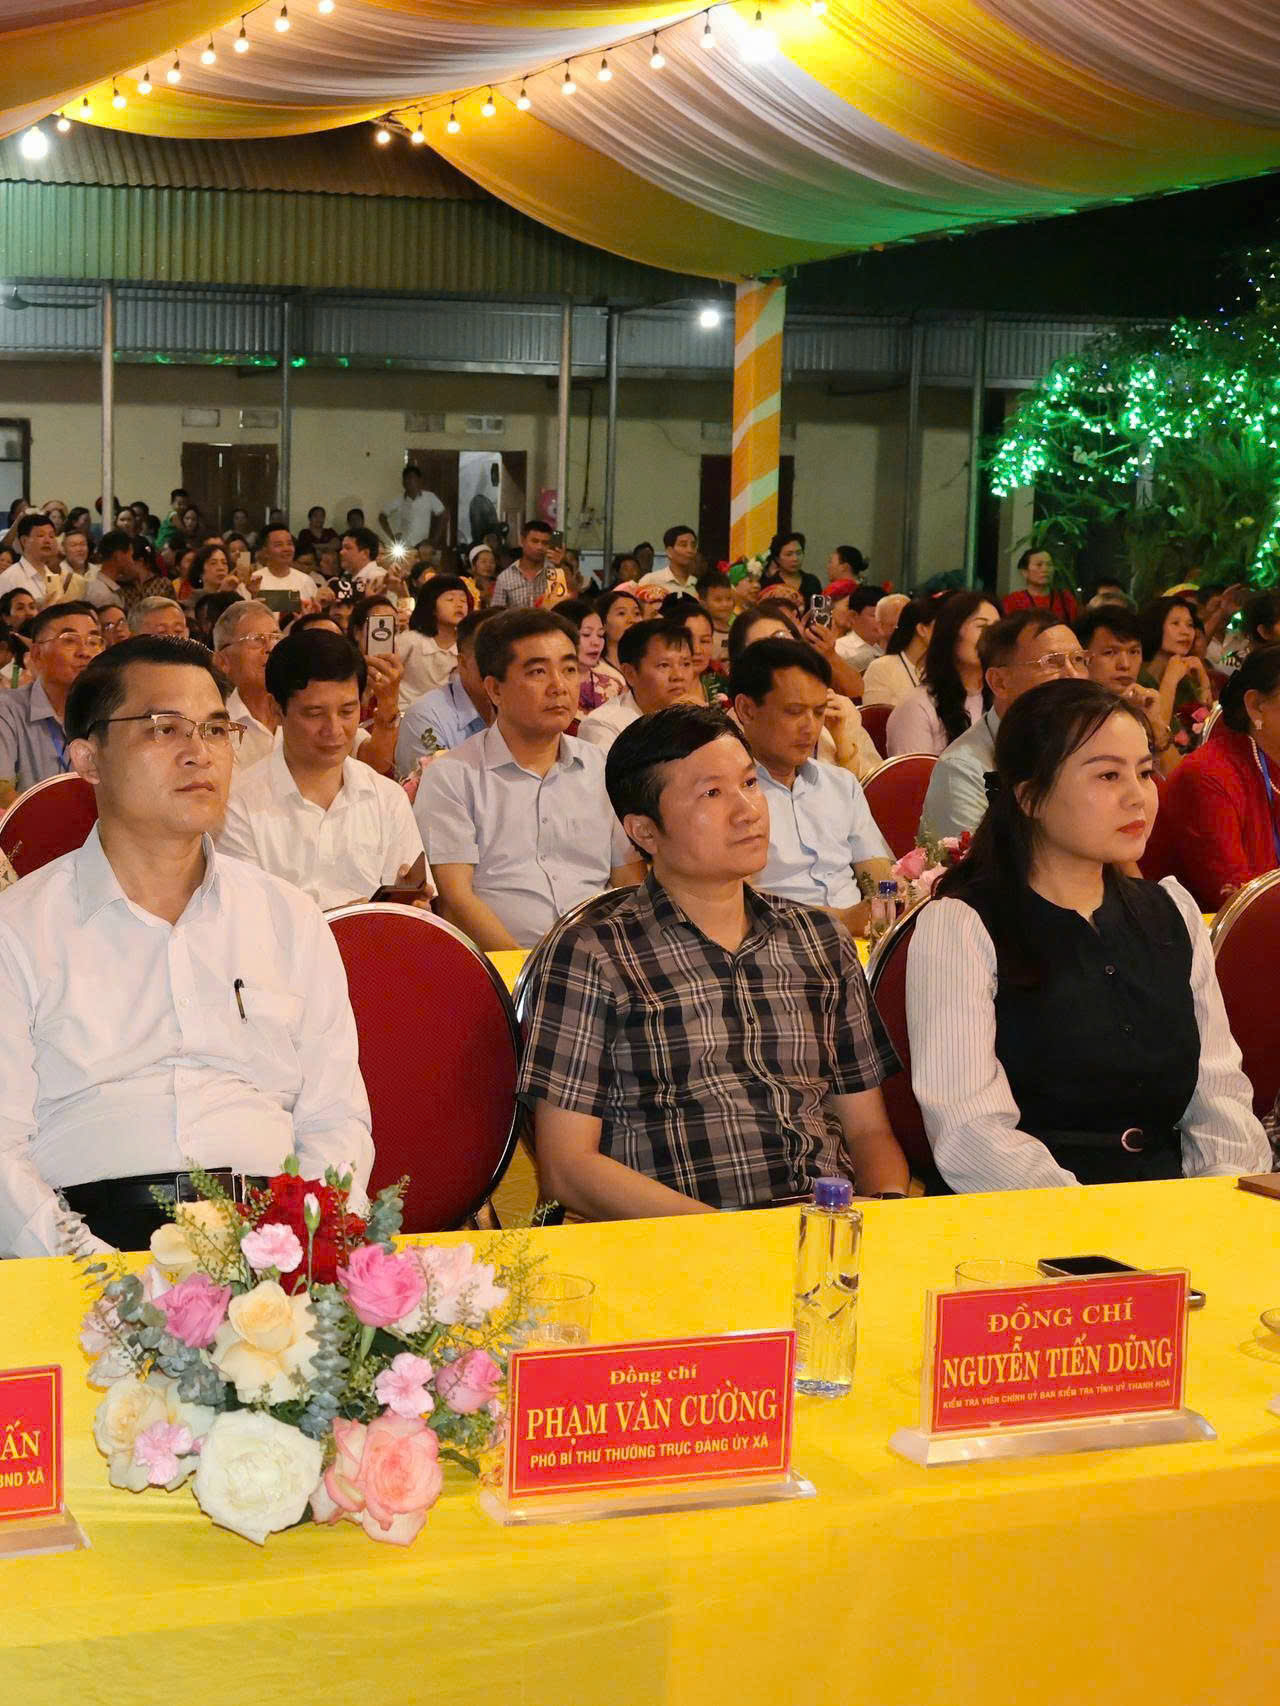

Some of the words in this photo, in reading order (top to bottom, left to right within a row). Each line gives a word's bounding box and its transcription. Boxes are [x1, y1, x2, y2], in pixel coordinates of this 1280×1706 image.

[988, 1302, 1072, 1333] ĐỒNG
[1082, 1297, 1134, 1324] CHÍ
[610, 1365, 662, 1385] Đồng
[667, 1364, 698, 1381] chí
[942, 1336, 1040, 1389] NGUYỄN
[1046, 1333, 1103, 1378] TIẾN
[1107, 1334, 1173, 1373] DŨNG
[965, 1398, 980, 1406] TRA
[1040, 1391, 1056, 1400] BAN
[1080, 1387, 1094, 1395] TRA
[1128, 1381, 1154, 1391] THANH
[526, 1402, 608, 1446] PHẠM
[615, 1391, 672, 1433] VĂN
[680, 1380, 777, 1427] CƯỜNG
[530, 1450, 556, 1468] PHÓ
[560, 1449, 572, 1465] BÍ
[576, 1448, 602, 1464] THƯ
[605, 1443, 656, 1461] THƯỜNG
[695, 1435, 728, 1453] ĐẢNG
[733, 1433, 749, 1450] ỦY
[753, 1432, 769, 1448] XÃ
[27, 1466, 45, 1485] XÃ
